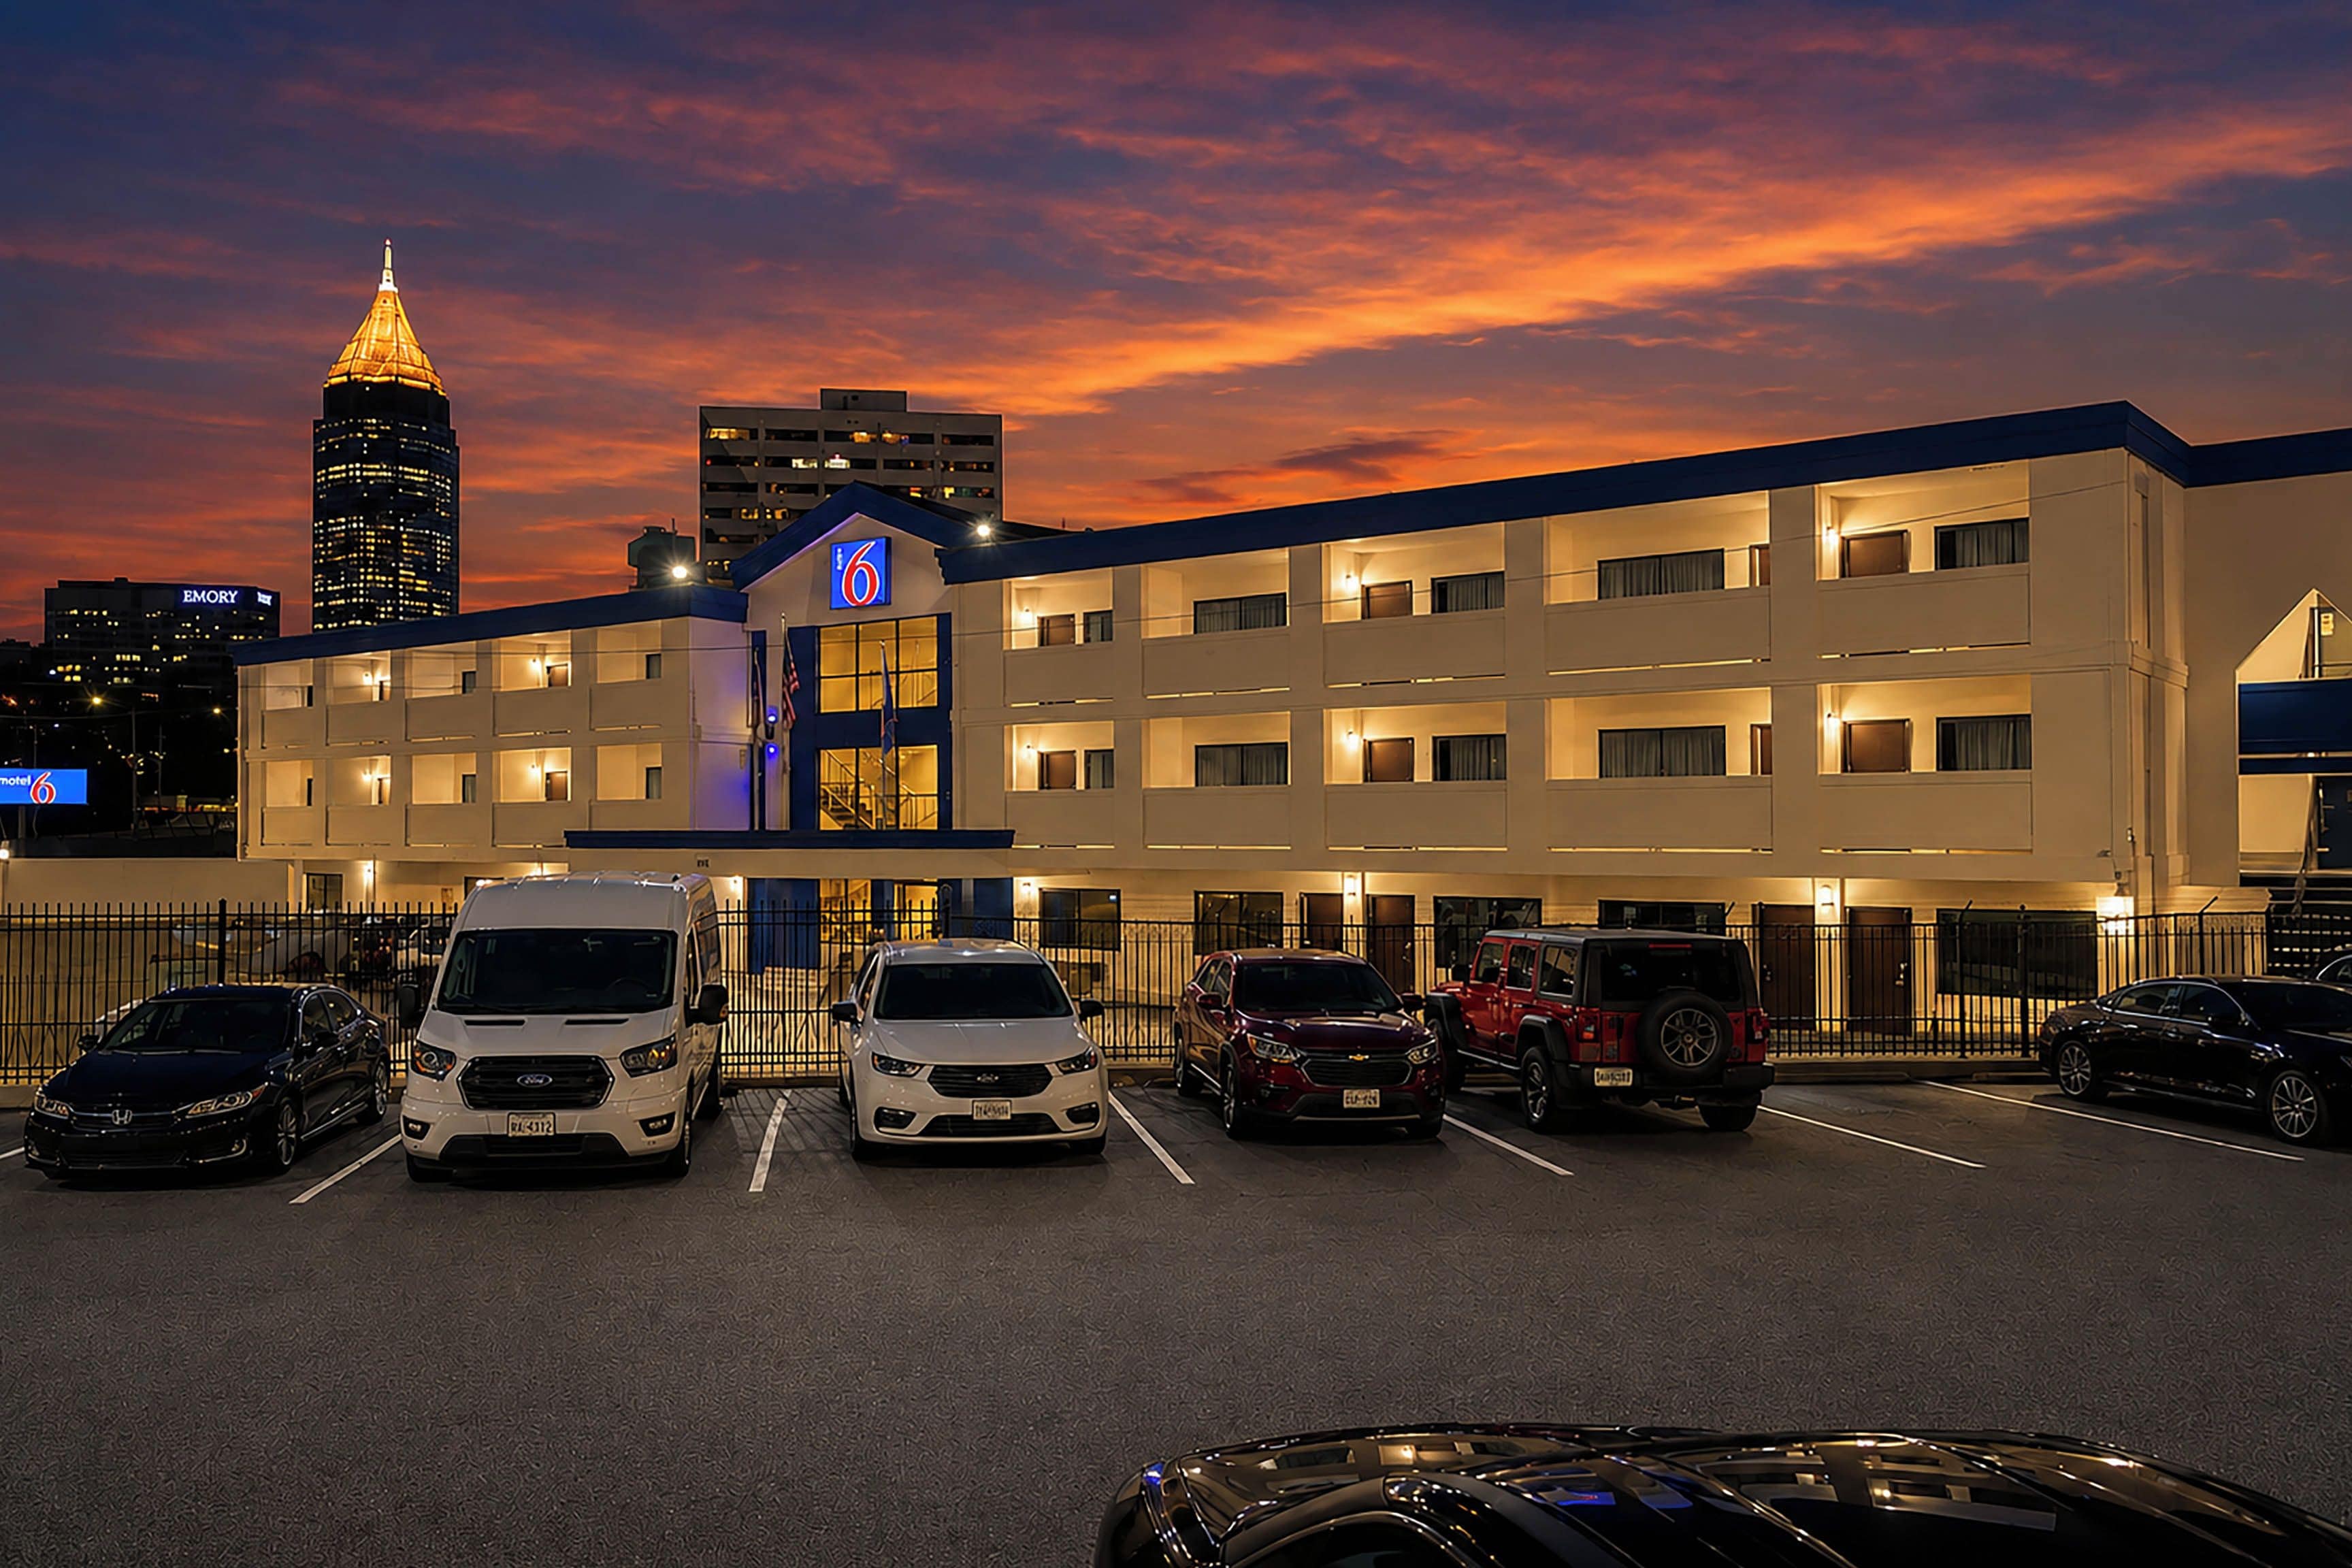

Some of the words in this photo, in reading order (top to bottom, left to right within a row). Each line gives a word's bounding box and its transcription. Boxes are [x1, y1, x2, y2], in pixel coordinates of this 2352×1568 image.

[842, 540, 880, 607] 6
[182, 589, 238, 604] EMORY
[0, 774, 31, 786] motel
[30, 771, 56, 804] 6
